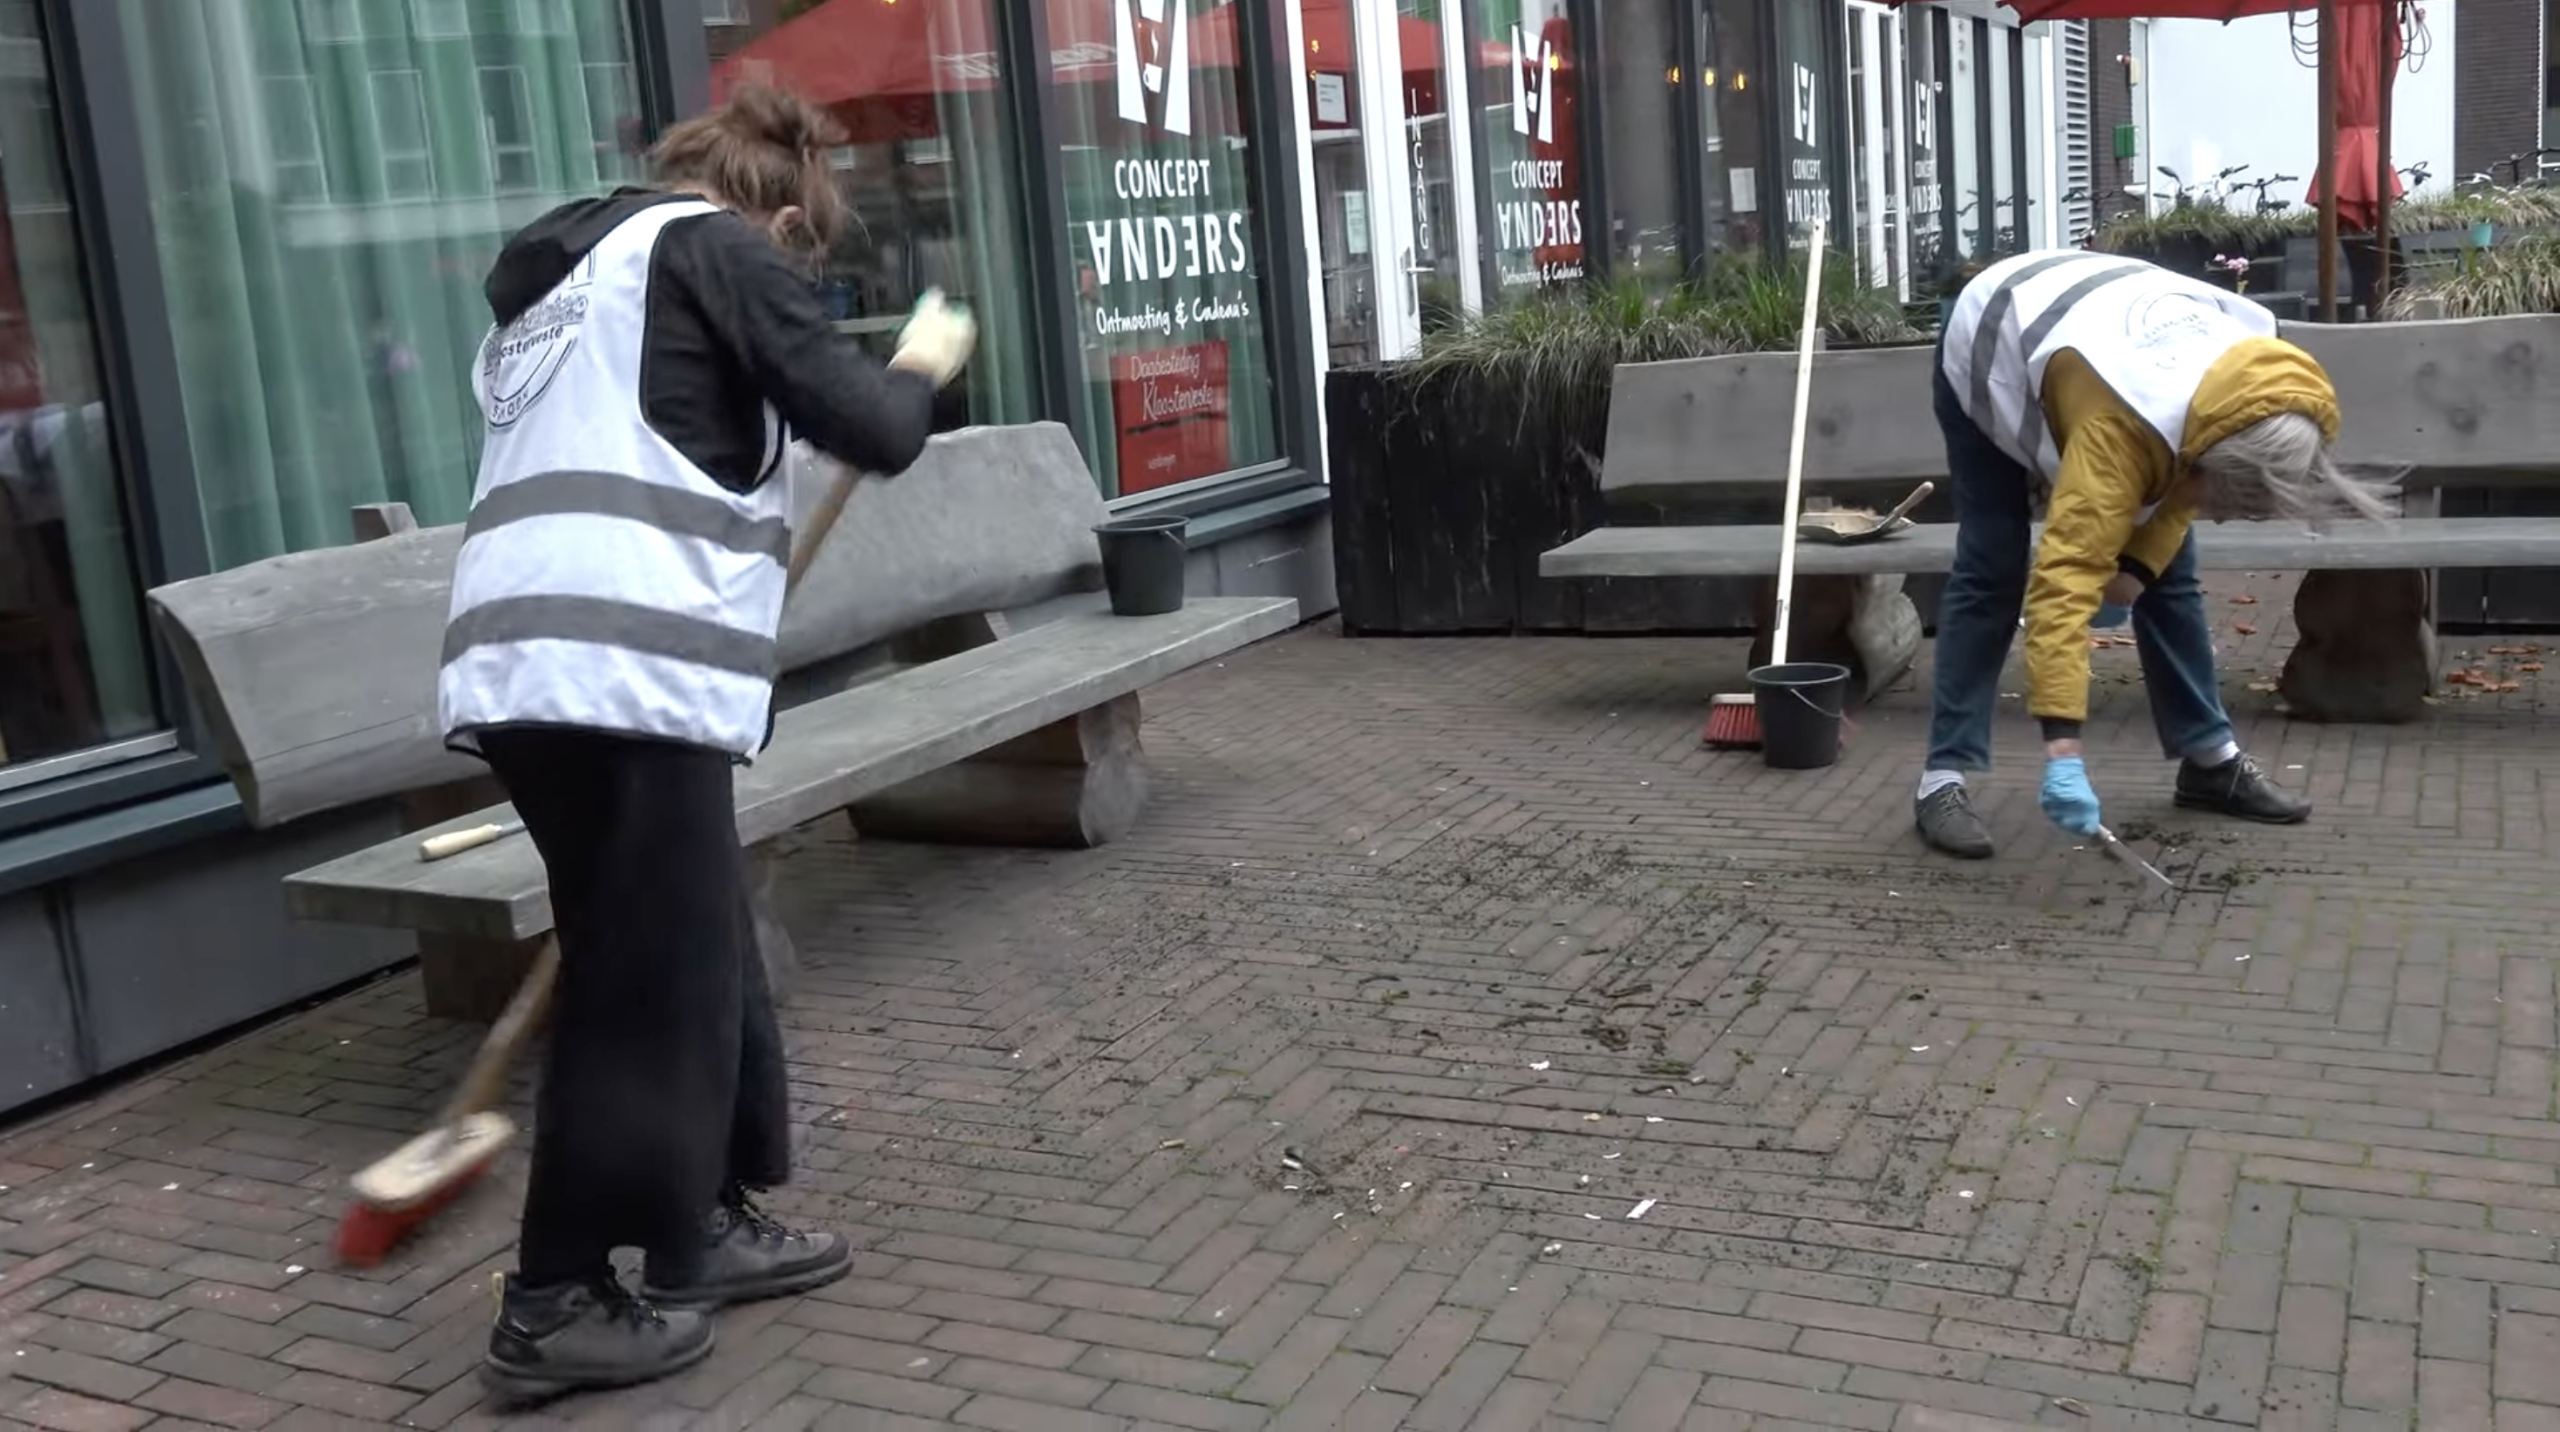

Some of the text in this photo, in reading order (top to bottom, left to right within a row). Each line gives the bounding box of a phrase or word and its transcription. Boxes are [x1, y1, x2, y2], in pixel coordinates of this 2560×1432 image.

[1114, 159, 1210, 199] CONCEPT
[1411, 87, 1429, 250] INGANG
[1511, 160, 1563, 189] CONCEPT
[1792, 159, 1821, 180] CONCEPT
[1096, 290, 1249, 336] Ontmoeting & Cadeau's
[1131, 349, 1200, 384] Dagbesteding
[1143, 379, 1213, 421] Kloosterveste
